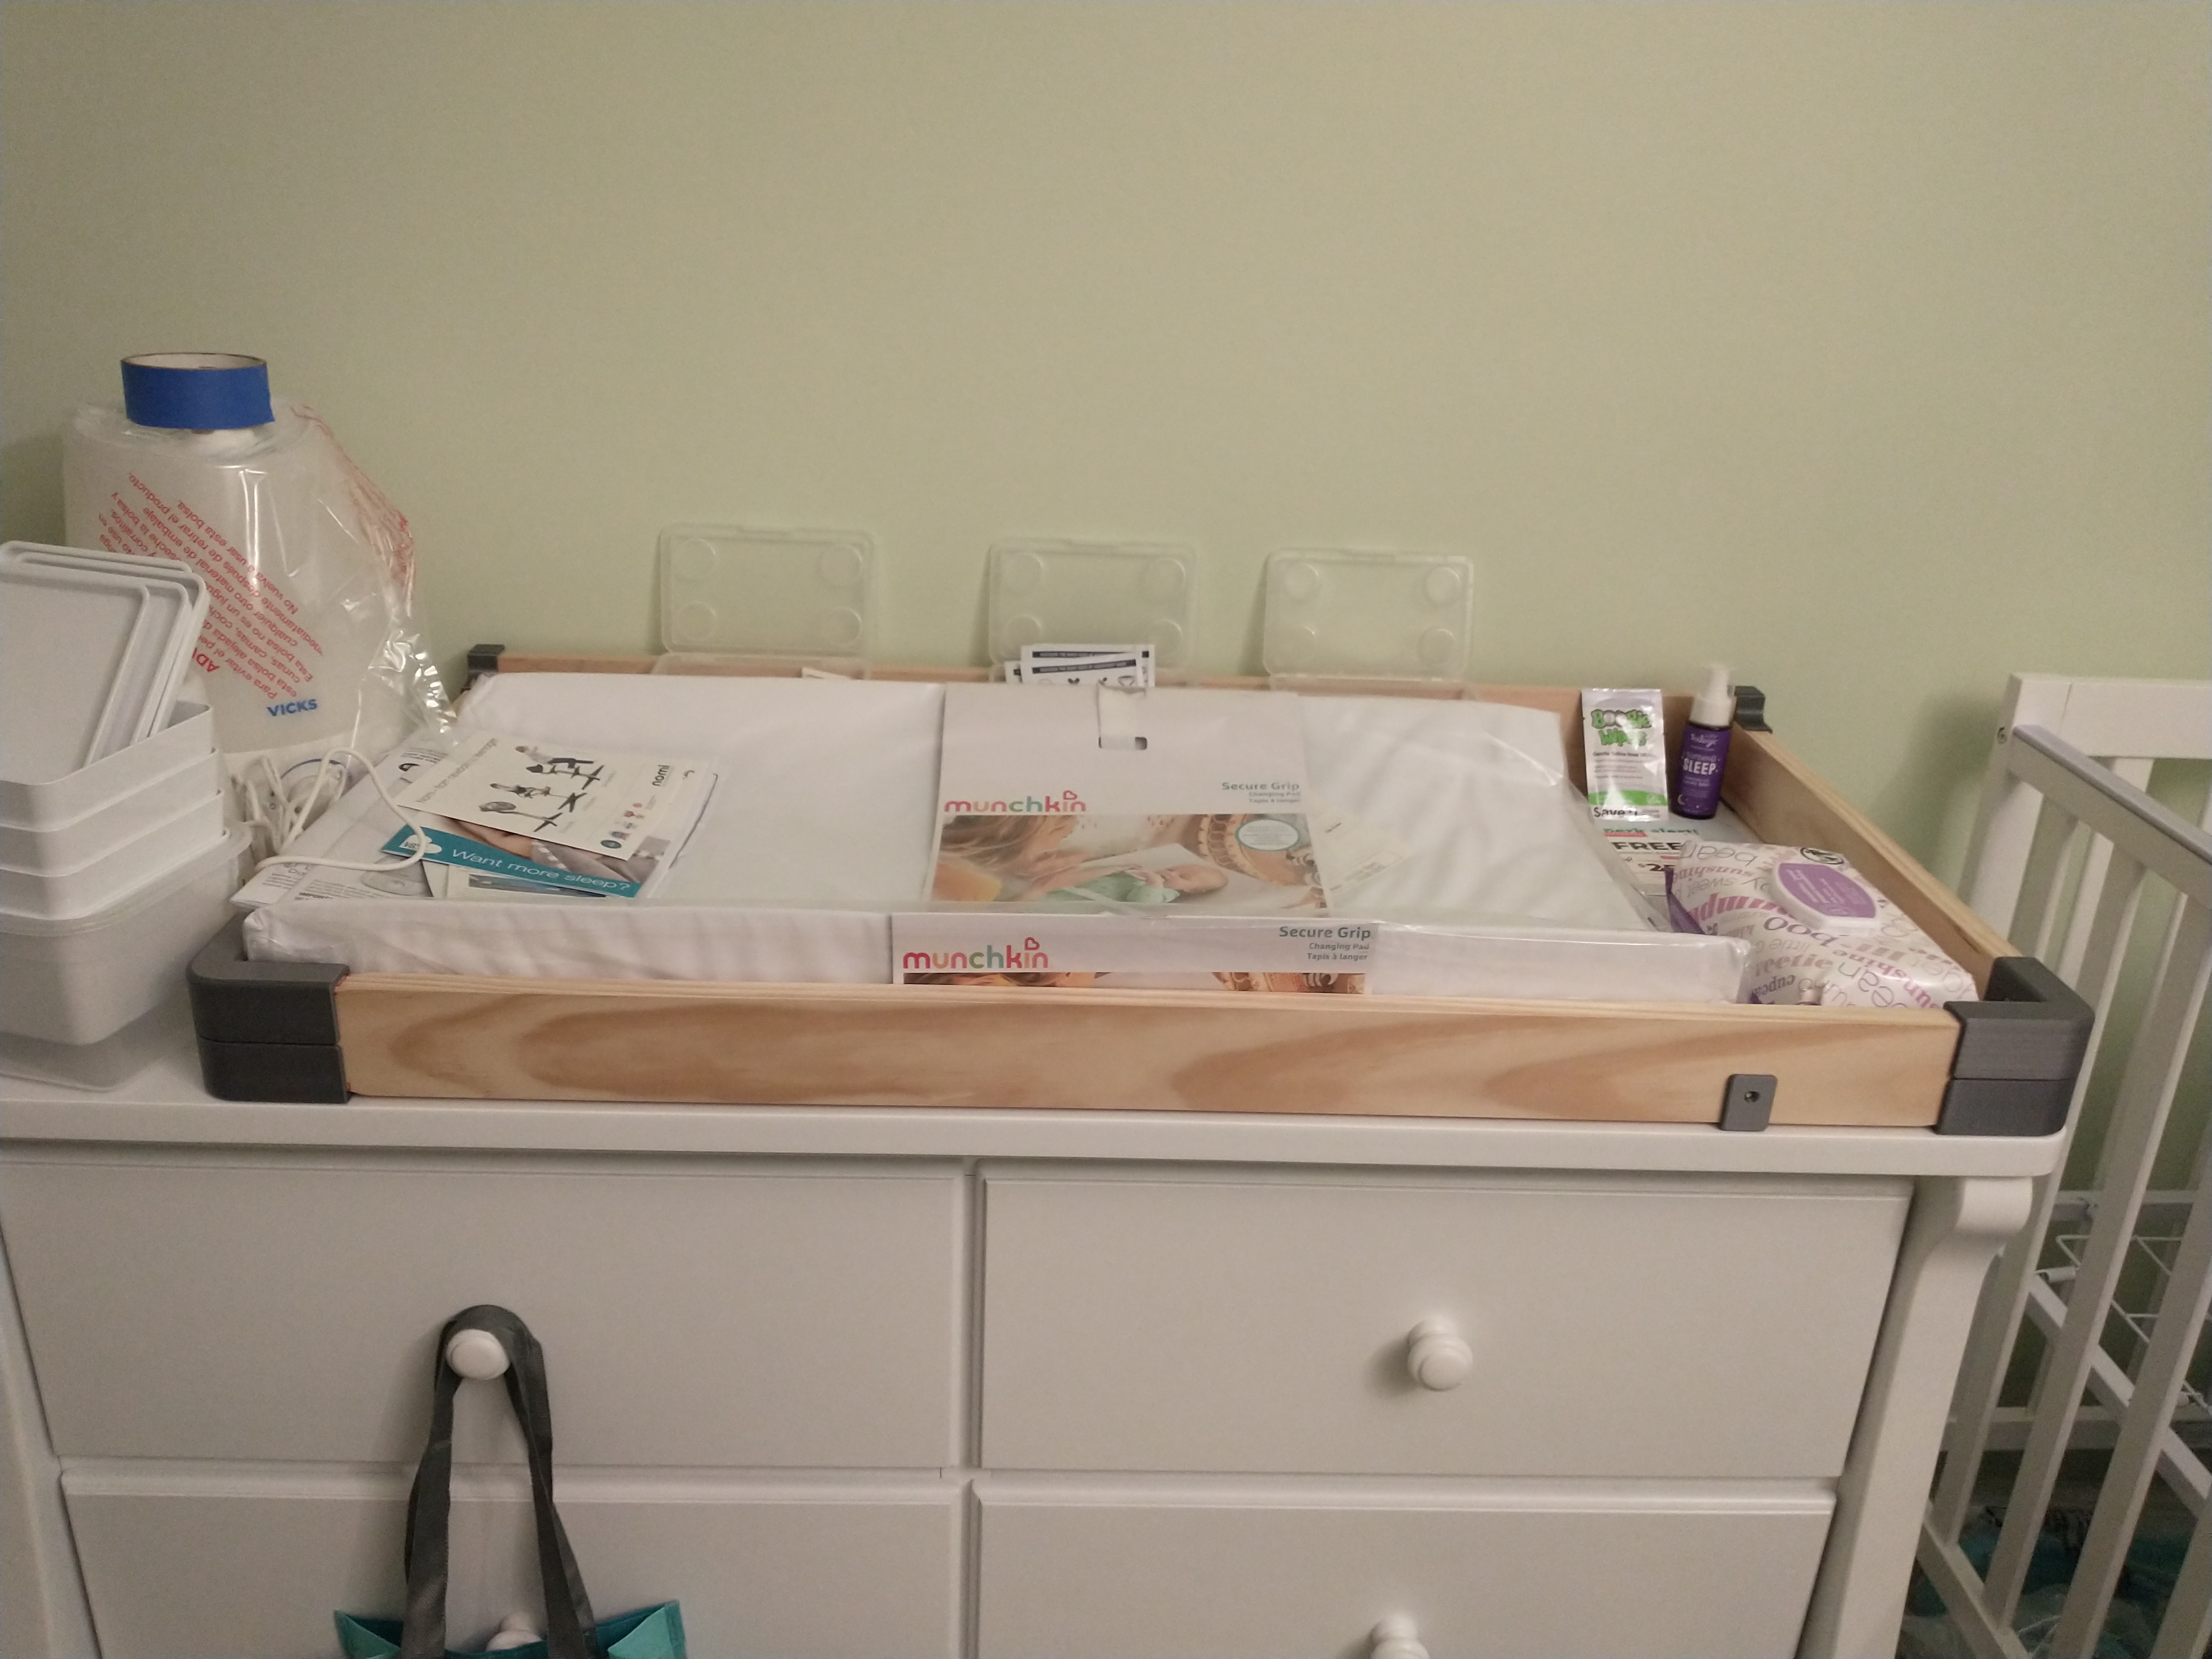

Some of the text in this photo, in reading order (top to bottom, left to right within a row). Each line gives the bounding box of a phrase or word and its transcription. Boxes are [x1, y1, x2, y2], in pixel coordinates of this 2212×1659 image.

[115, 498, 139, 524] bolsa
[168, 514, 179, 525] el
[139, 524, 149, 534] la
[180, 523, 208, 551] retirar
[204, 525, 227, 548] esta
[206, 549, 222, 564] de
[226, 546, 248, 566] usar
[142, 507, 297, 648] cualquier otro material de embalaje
[255, 572, 284, 599] vuelva
[227, 604, 239, 616] un
[283, 597, 299, 614] No
[240, 617, 252, 627] es
[212, 627, 247, 660] alejada
[252, 627, 265, 640] no
[213, 648, 225, 659] el
[266, 637, 295, 662] bolsa
[225, 657, 252, 682] evitar
[247, 657, 276, 683] bolsa
[293, 660, 313, 683] Esta
[252, 677, 278, 700] Para
[276, 678, 297, 698] esta
[267, 698, 318, 717] VICKS
[652, 764, 671, 788] nomi
[1683, 757, 1716, 775] SLEEP
[1222, 782, 1299, 791] Secure Grip
[944, 790, 1086, 812] munchkin
[1611, 842, 1682, 851] FREE
[453, 848, 630, 891] Want more sleep?
[1279, 926, 1371, 941] Secure Grip
[1763, 917, 1839, 947] boo
[902, 937, 1049, 969] munchkin
[1309, 942, 1350, 951] Changing
[1307, 953, 1330, 961] Tapis
[1340, 953, 1369, 962] langer
